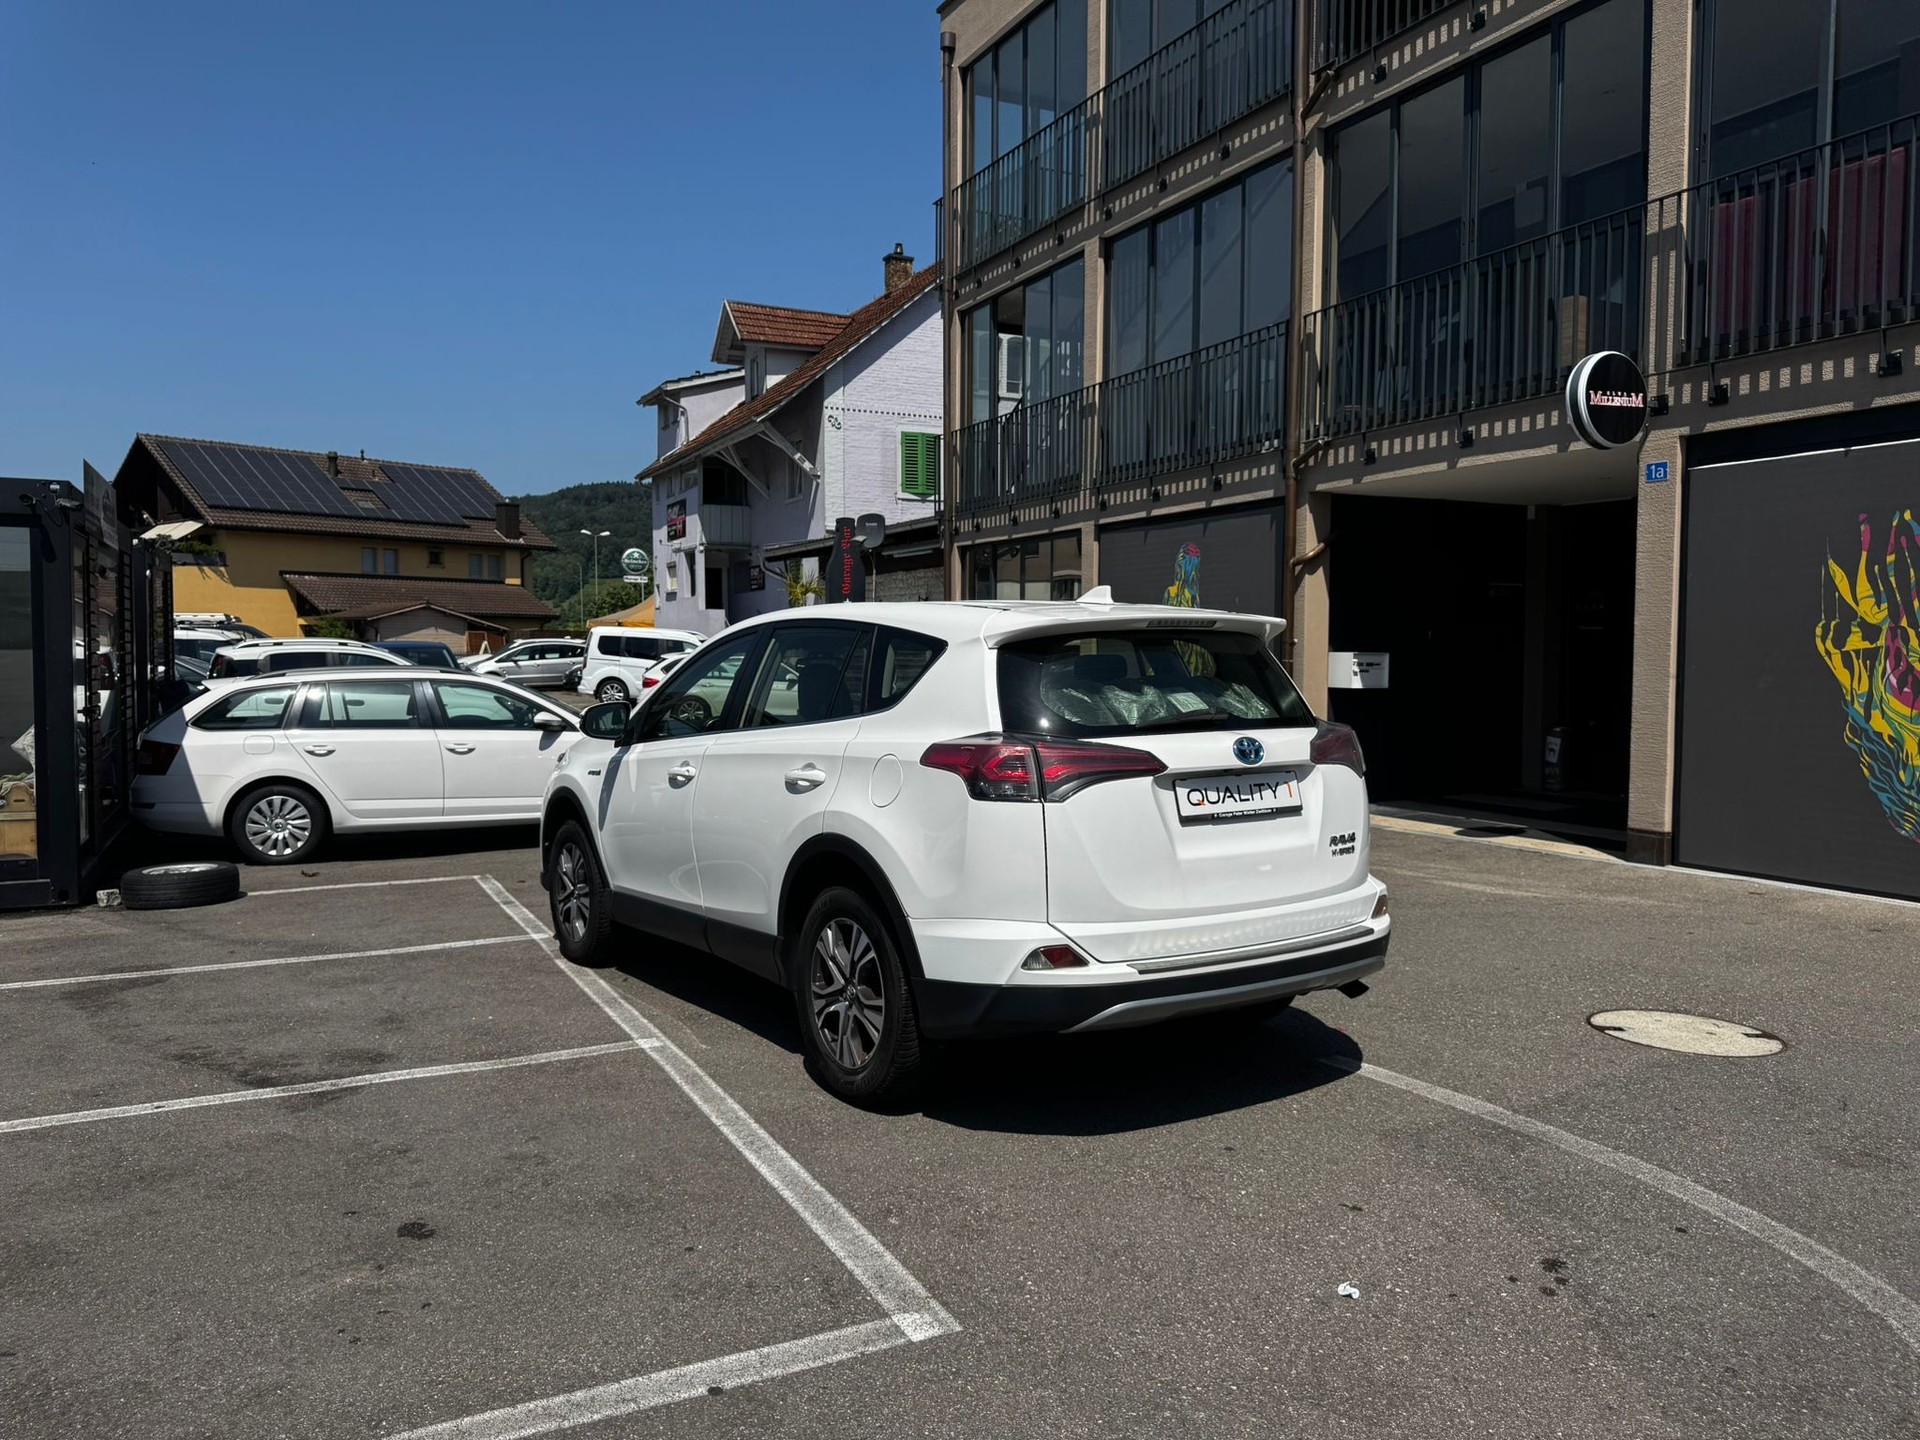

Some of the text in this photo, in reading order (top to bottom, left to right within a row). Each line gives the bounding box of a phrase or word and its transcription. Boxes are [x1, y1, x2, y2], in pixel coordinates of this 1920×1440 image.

[1650, 464, 1664, 479] 1a
[841, 553, 854, 595] Garage
[1187, 781, 1293, 806] QUALITY 1
[1329, 832, 1356, 847] RAV4
